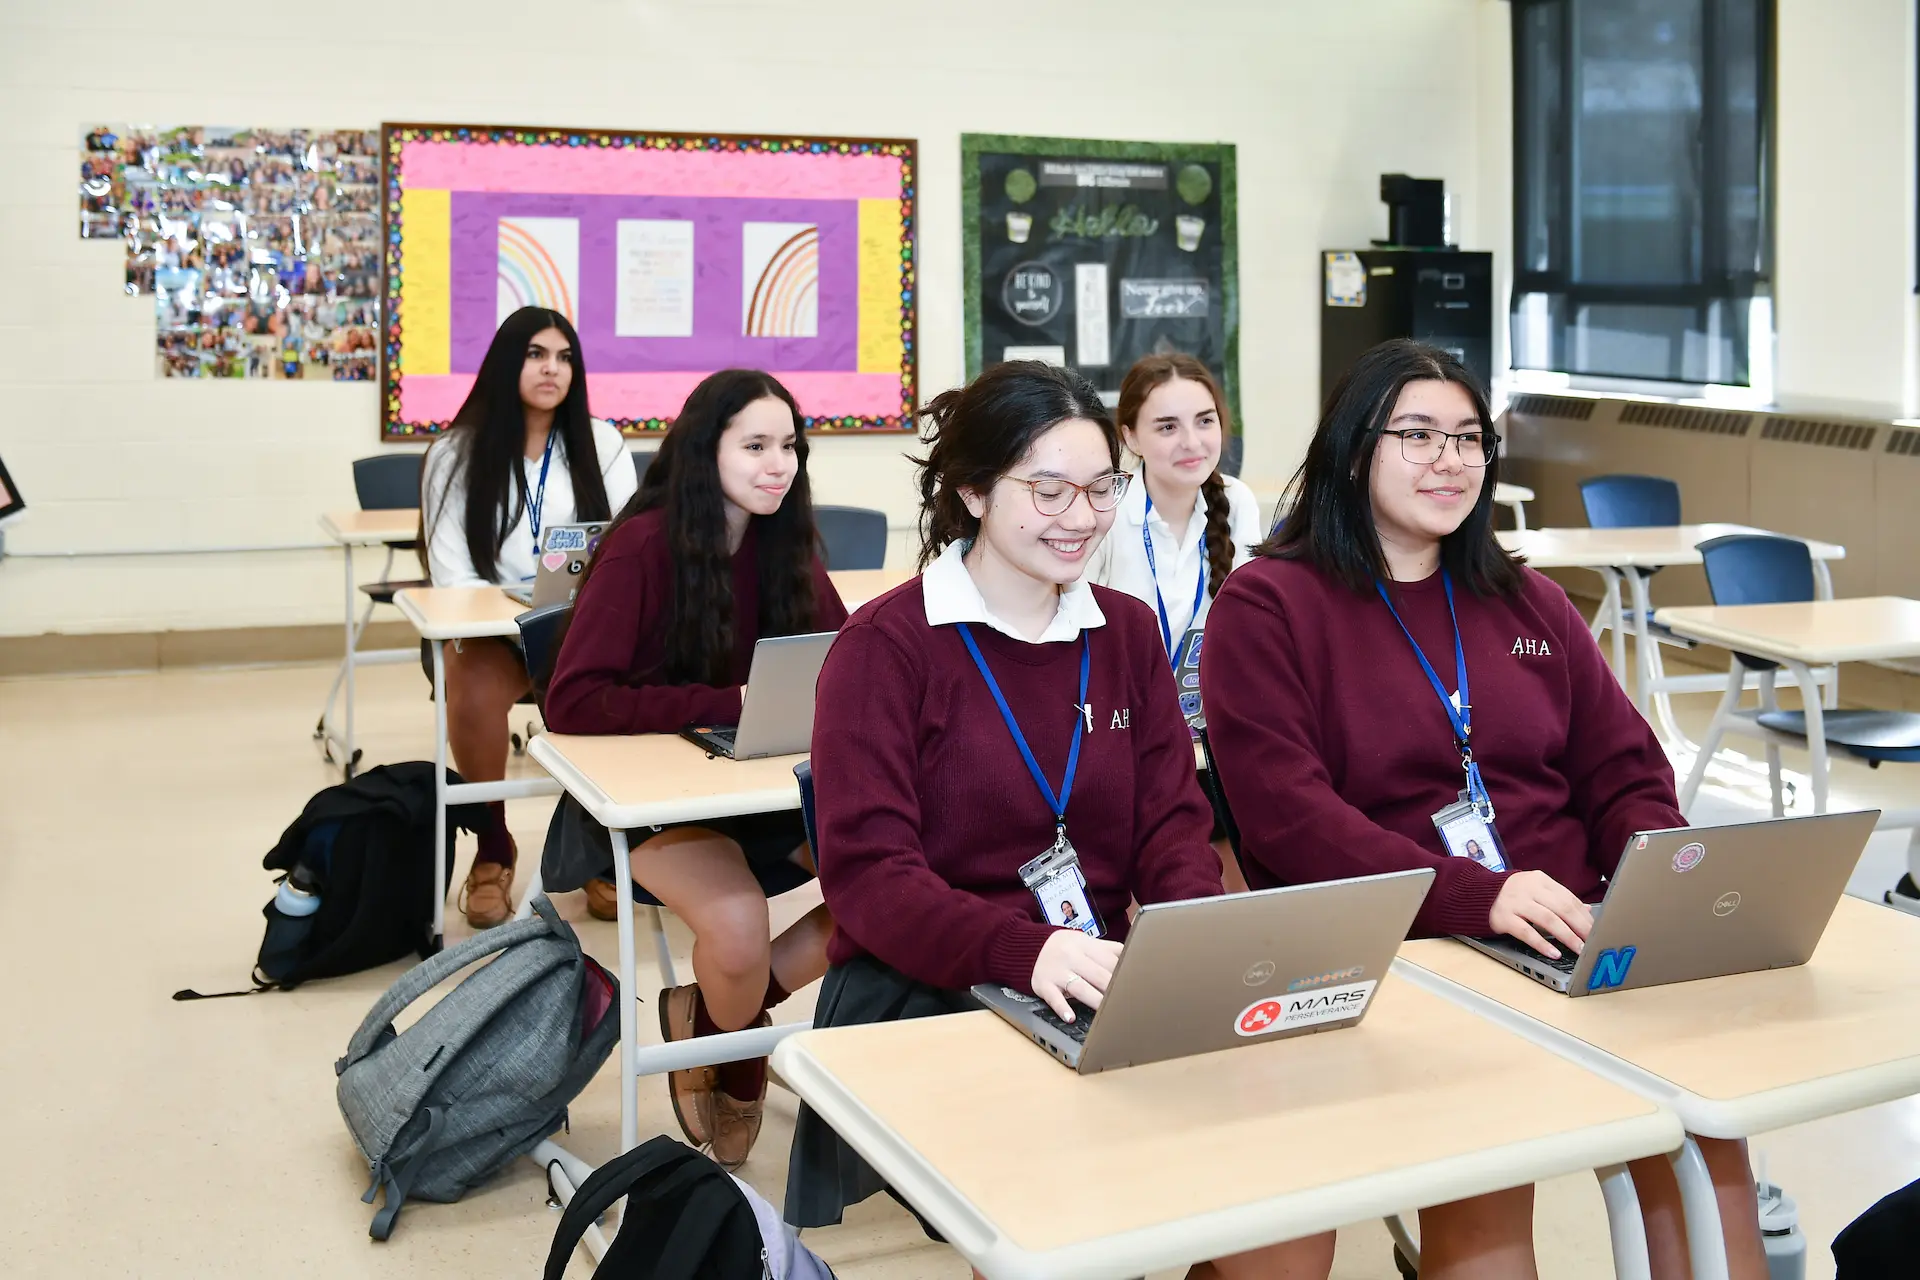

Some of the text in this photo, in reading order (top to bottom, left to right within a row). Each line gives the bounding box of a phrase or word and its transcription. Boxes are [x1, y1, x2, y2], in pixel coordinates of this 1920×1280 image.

[551, 529, 583, 541] Playa
[1511, 636, 1551, 656] AHA
[1588, 945, 1636, 990] N
[1289, 989, 1366, 1012] MARS
[1284, 1003, 1360, 1021] PERSEVERANCE
